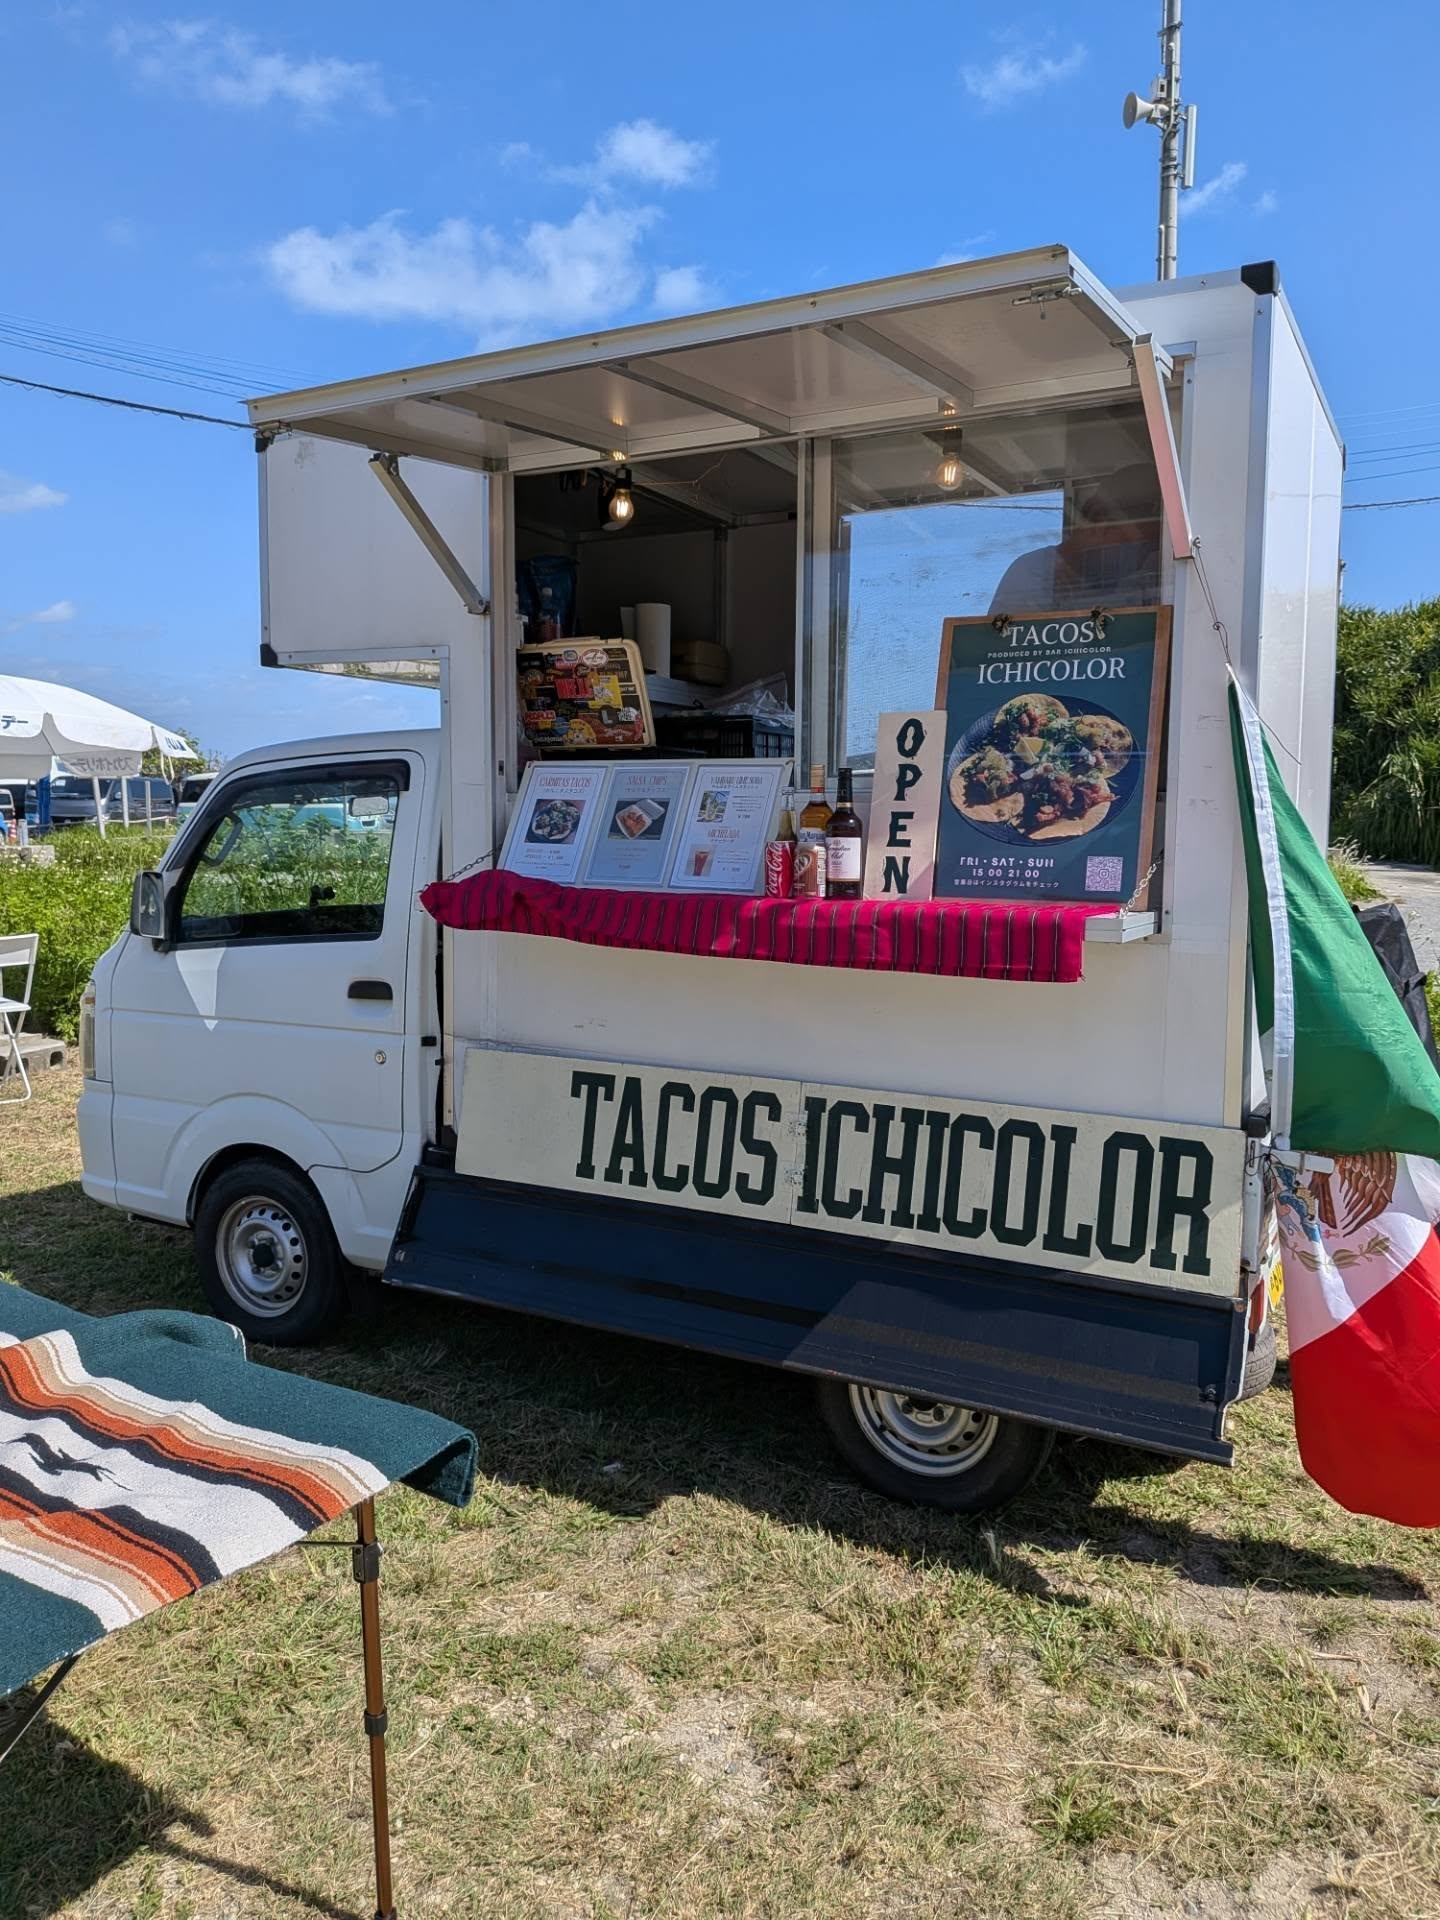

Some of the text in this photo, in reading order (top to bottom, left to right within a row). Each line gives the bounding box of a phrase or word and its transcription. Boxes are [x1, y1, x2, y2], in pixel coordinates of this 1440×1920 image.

[1007, 621, 1095, 648] TACOS
[987, 646, 1112, 659] PRODUCED BY BAR ICHICOLOR
[977, 656, 1127, 685] ICHICOLOR
[881, 717, 928, 895] OPEN
[959, 856, 1054, 868] FRI SAT SUN
[569, 1069, 1216, 1277] TACOS ICHICOLOR
